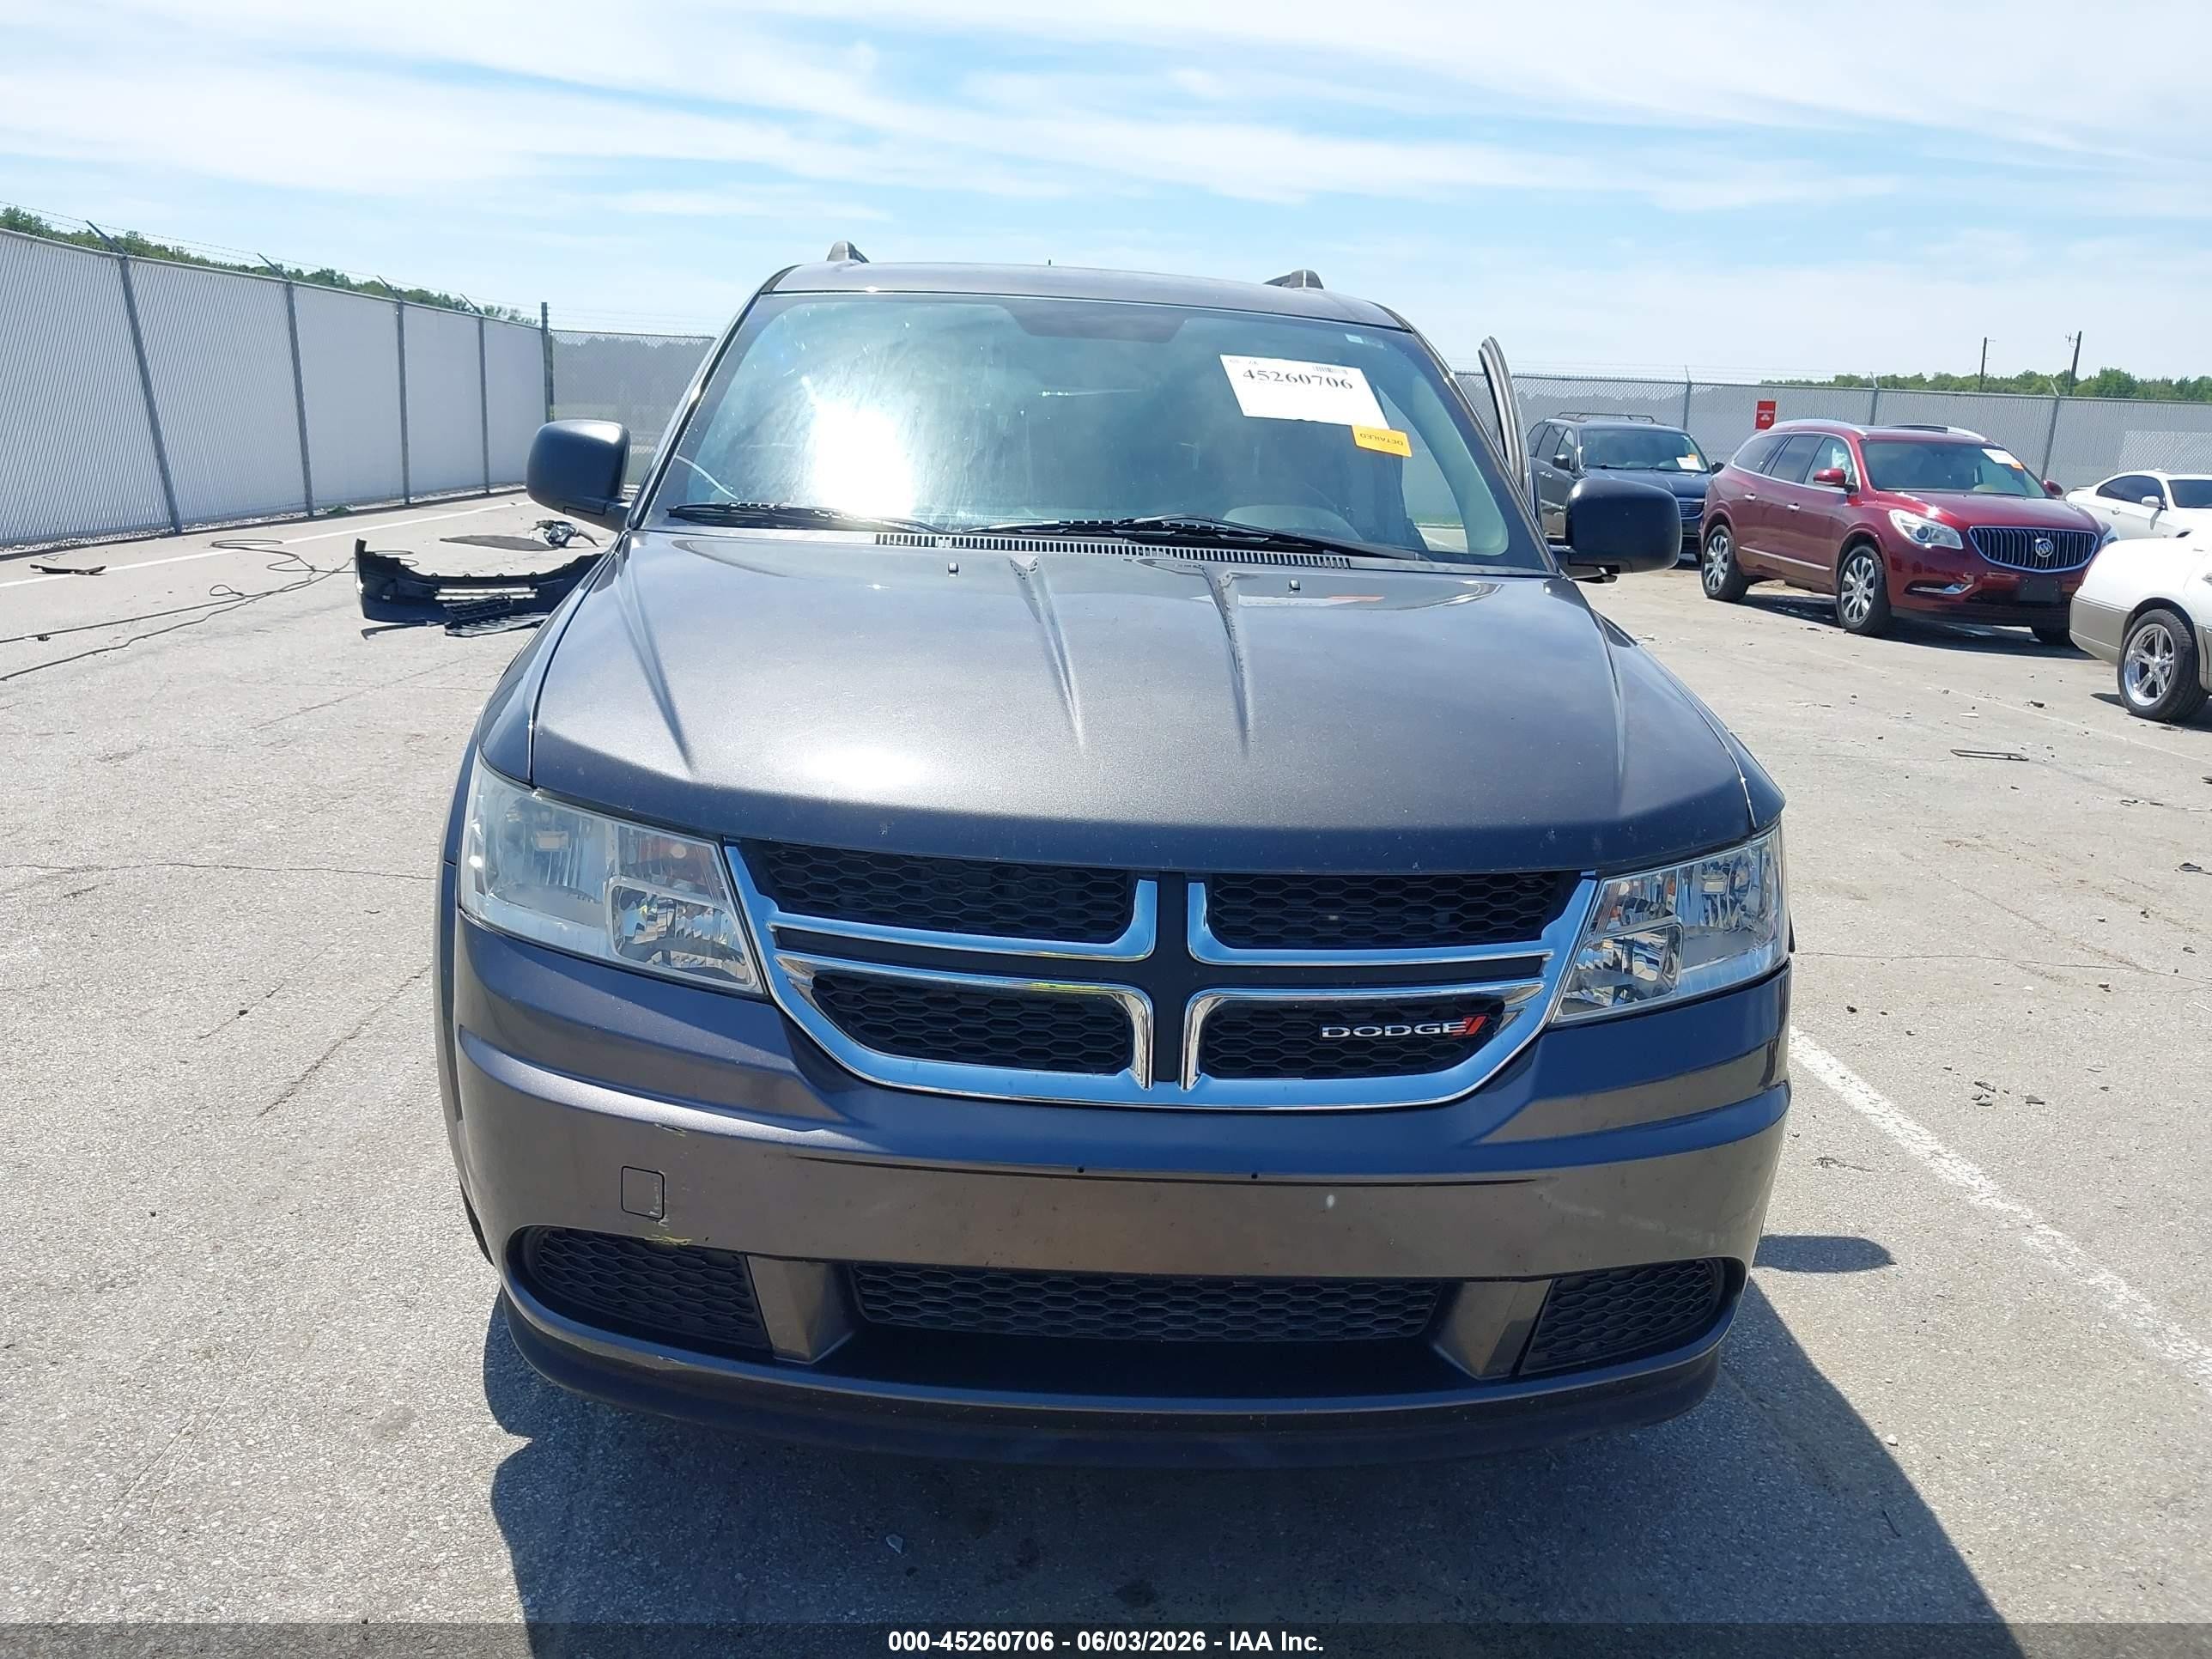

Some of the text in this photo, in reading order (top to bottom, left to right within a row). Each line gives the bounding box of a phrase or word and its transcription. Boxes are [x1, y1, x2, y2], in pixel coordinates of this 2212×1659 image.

[1243, 369, 1353, 390] 45260706
[1359, 433, 1404, 447] DETAILED
[1322, 1021, 1468, 1038] DODGE
